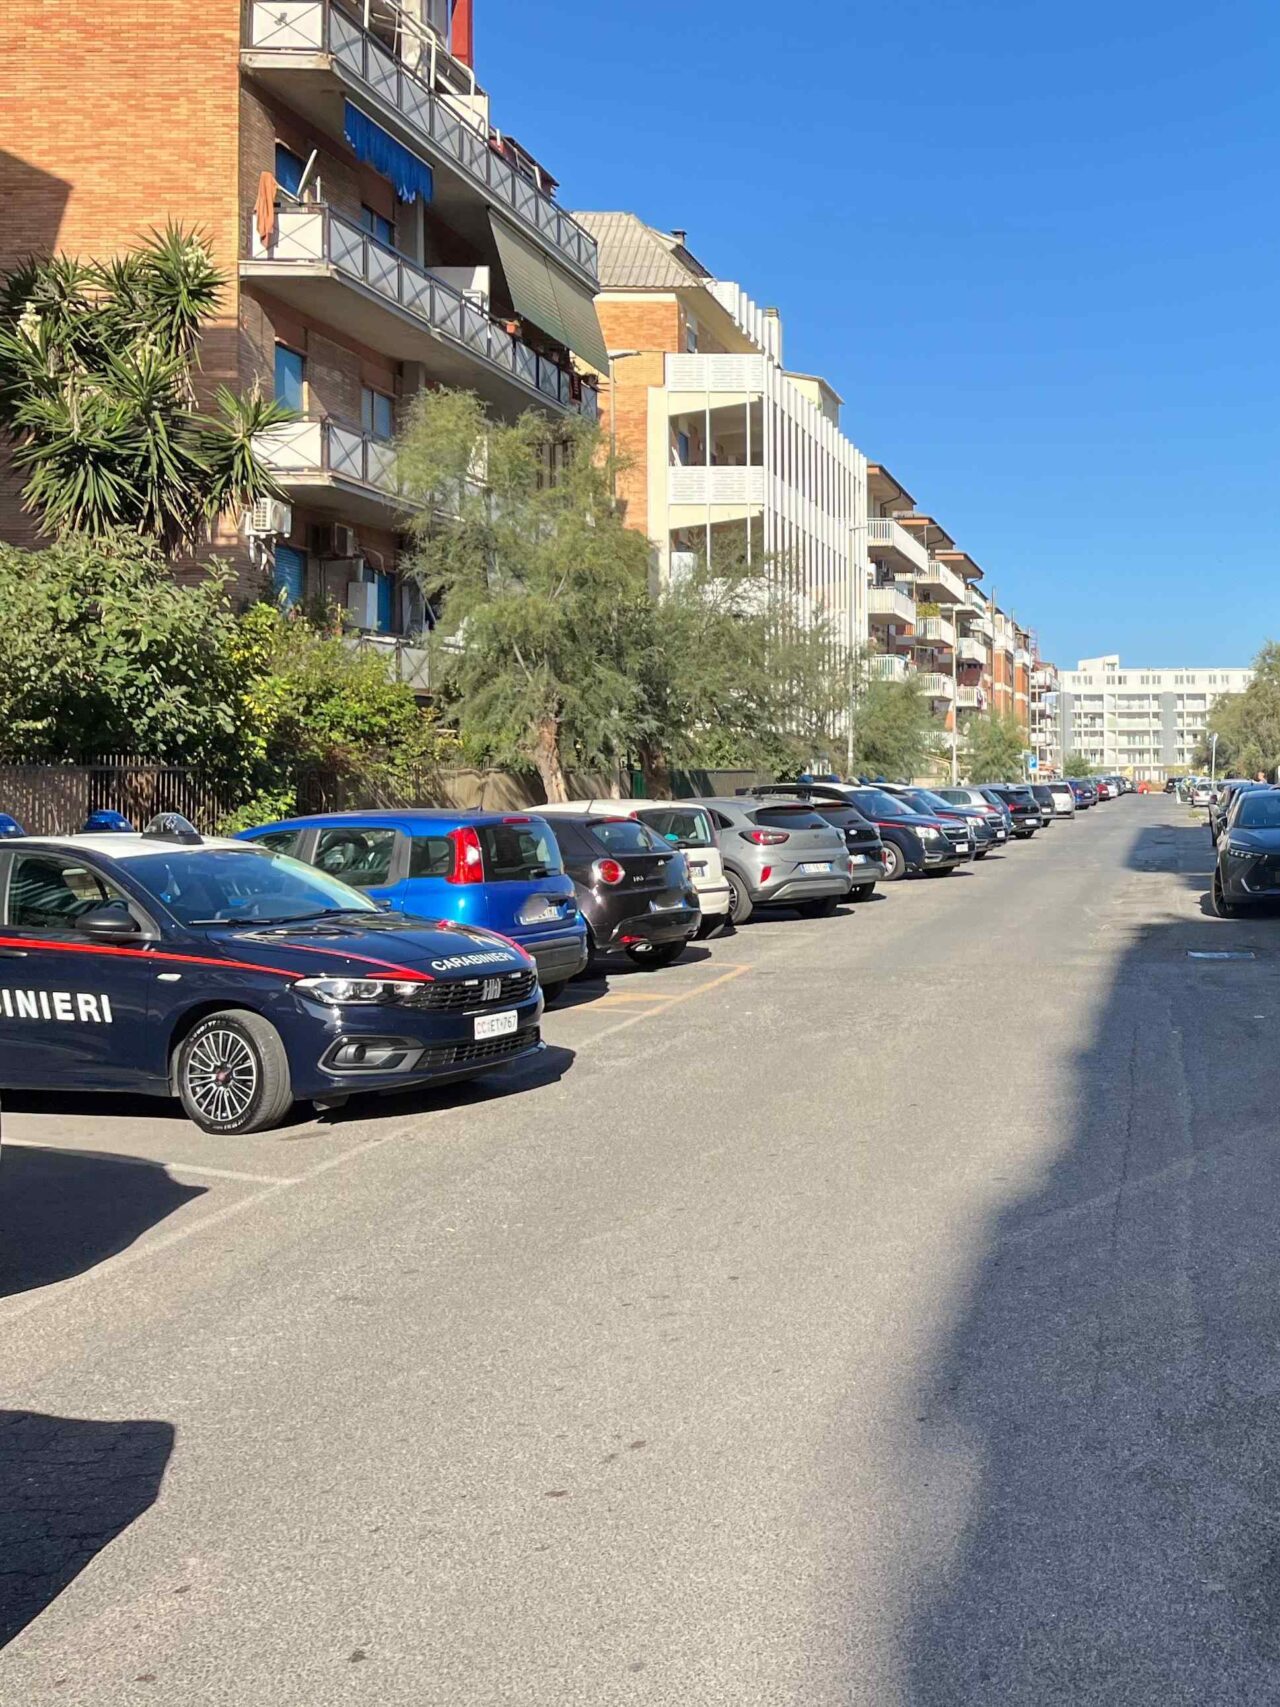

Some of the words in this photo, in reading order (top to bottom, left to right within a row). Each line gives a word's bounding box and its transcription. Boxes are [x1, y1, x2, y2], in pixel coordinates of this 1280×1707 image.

[431, 952, 516, 971] CARABINIERI
[0, 989, 113, 1023] INIERI
[476, 1021, 487, 1035] CC
[490, 1018, 501, 1032] ET
[503, 1015, 516, 1031] 767
